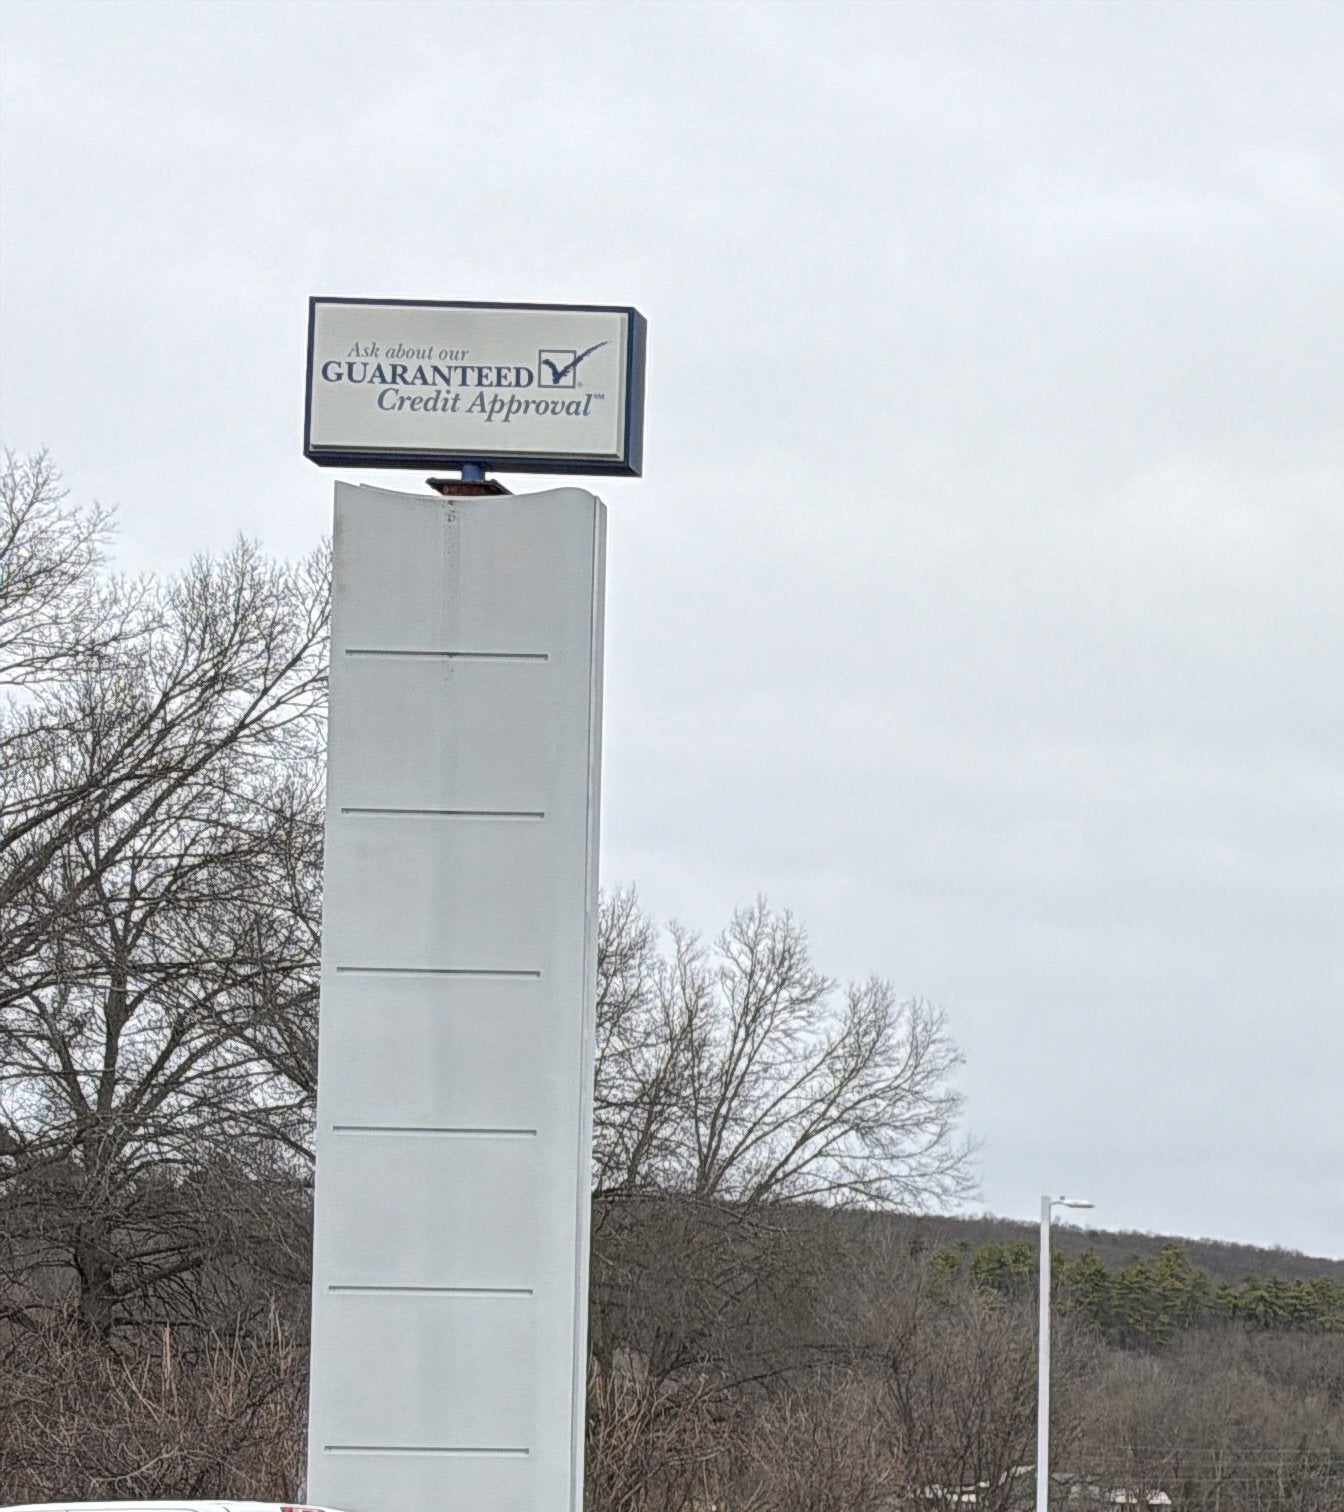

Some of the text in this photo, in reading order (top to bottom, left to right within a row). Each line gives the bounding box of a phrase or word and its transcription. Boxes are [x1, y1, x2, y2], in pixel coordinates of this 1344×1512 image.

[347, 341, 470, 361] Ask about our
[321, 360, 534, 388] GUARANTEED
[377, 387, 461, 413] Credit
[465, 390, 593, 423] Approval
